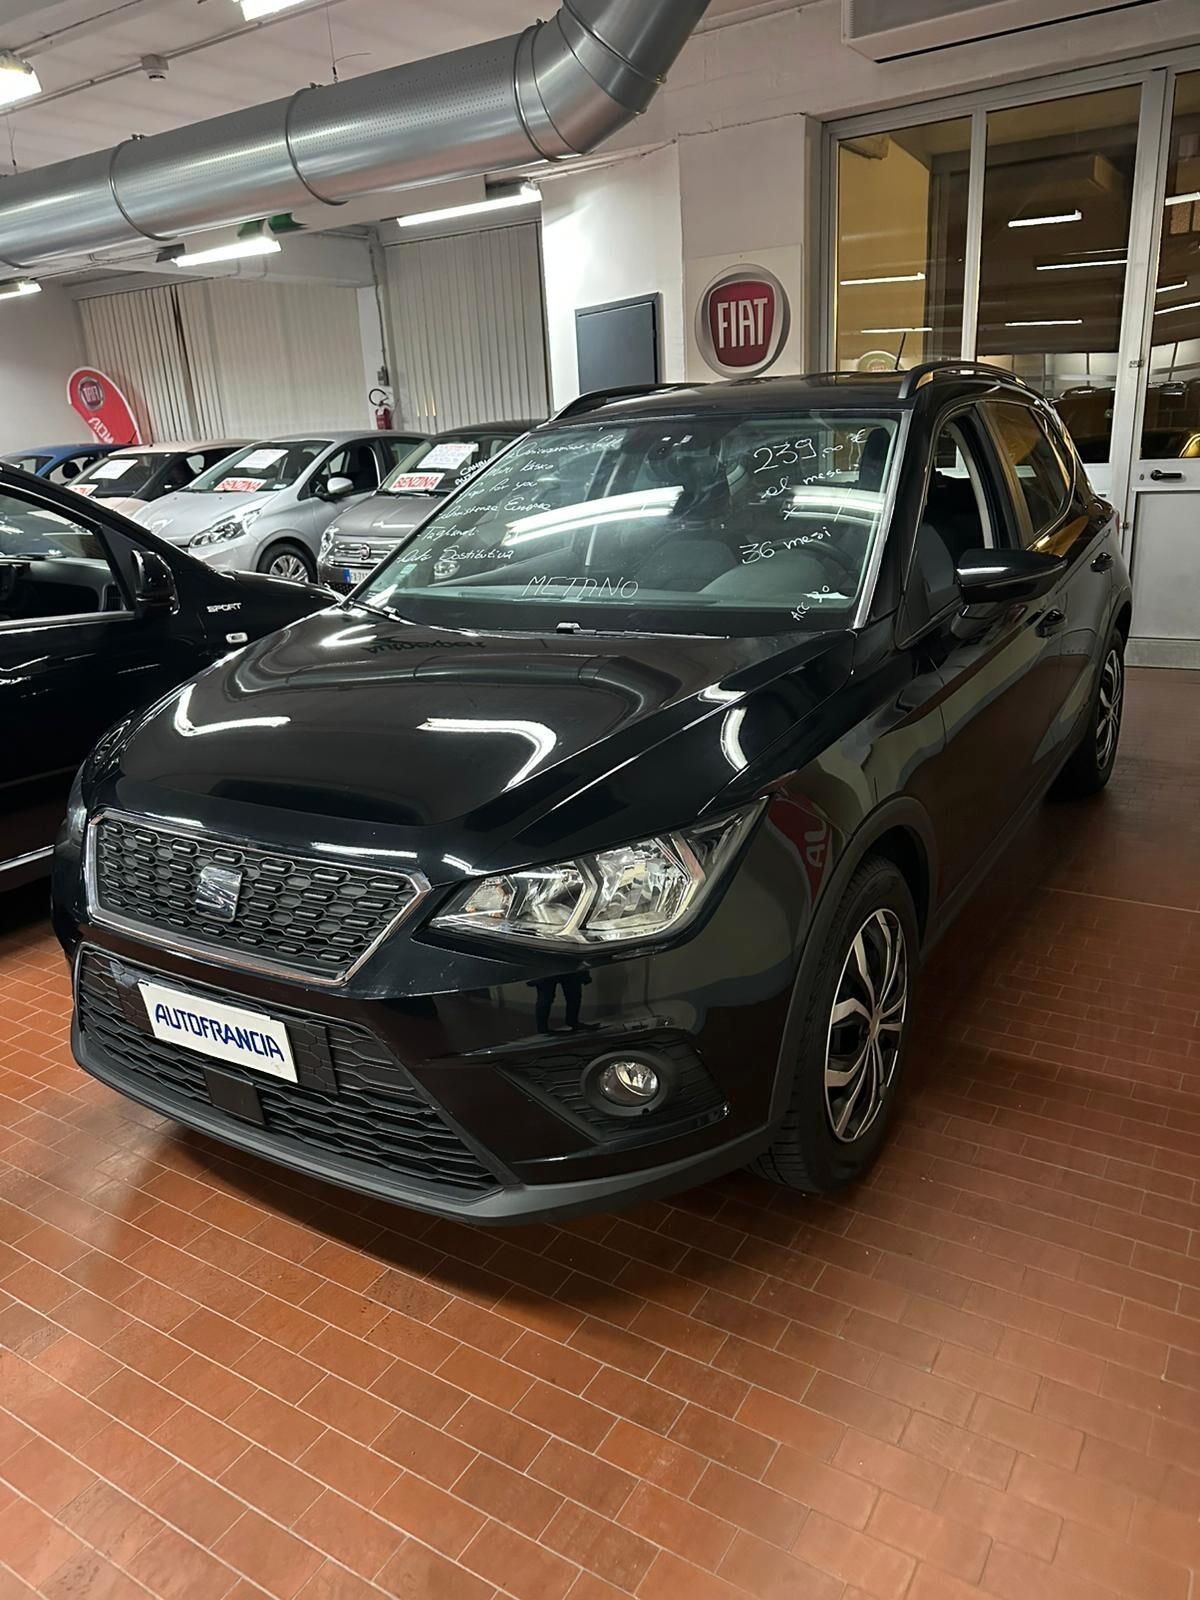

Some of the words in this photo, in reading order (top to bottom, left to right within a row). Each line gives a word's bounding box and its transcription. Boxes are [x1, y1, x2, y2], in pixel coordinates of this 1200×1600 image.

[717, 297, 768, 349] FIAT
[392, 475, 439, 489] BENZINA
[739, 540, 775, 565] 36
[521, 575, 639, 599] METANO
[206, 602, 242, 613] SPORT
[155, 1003, 285, 1062] AUTOFRANCIA
